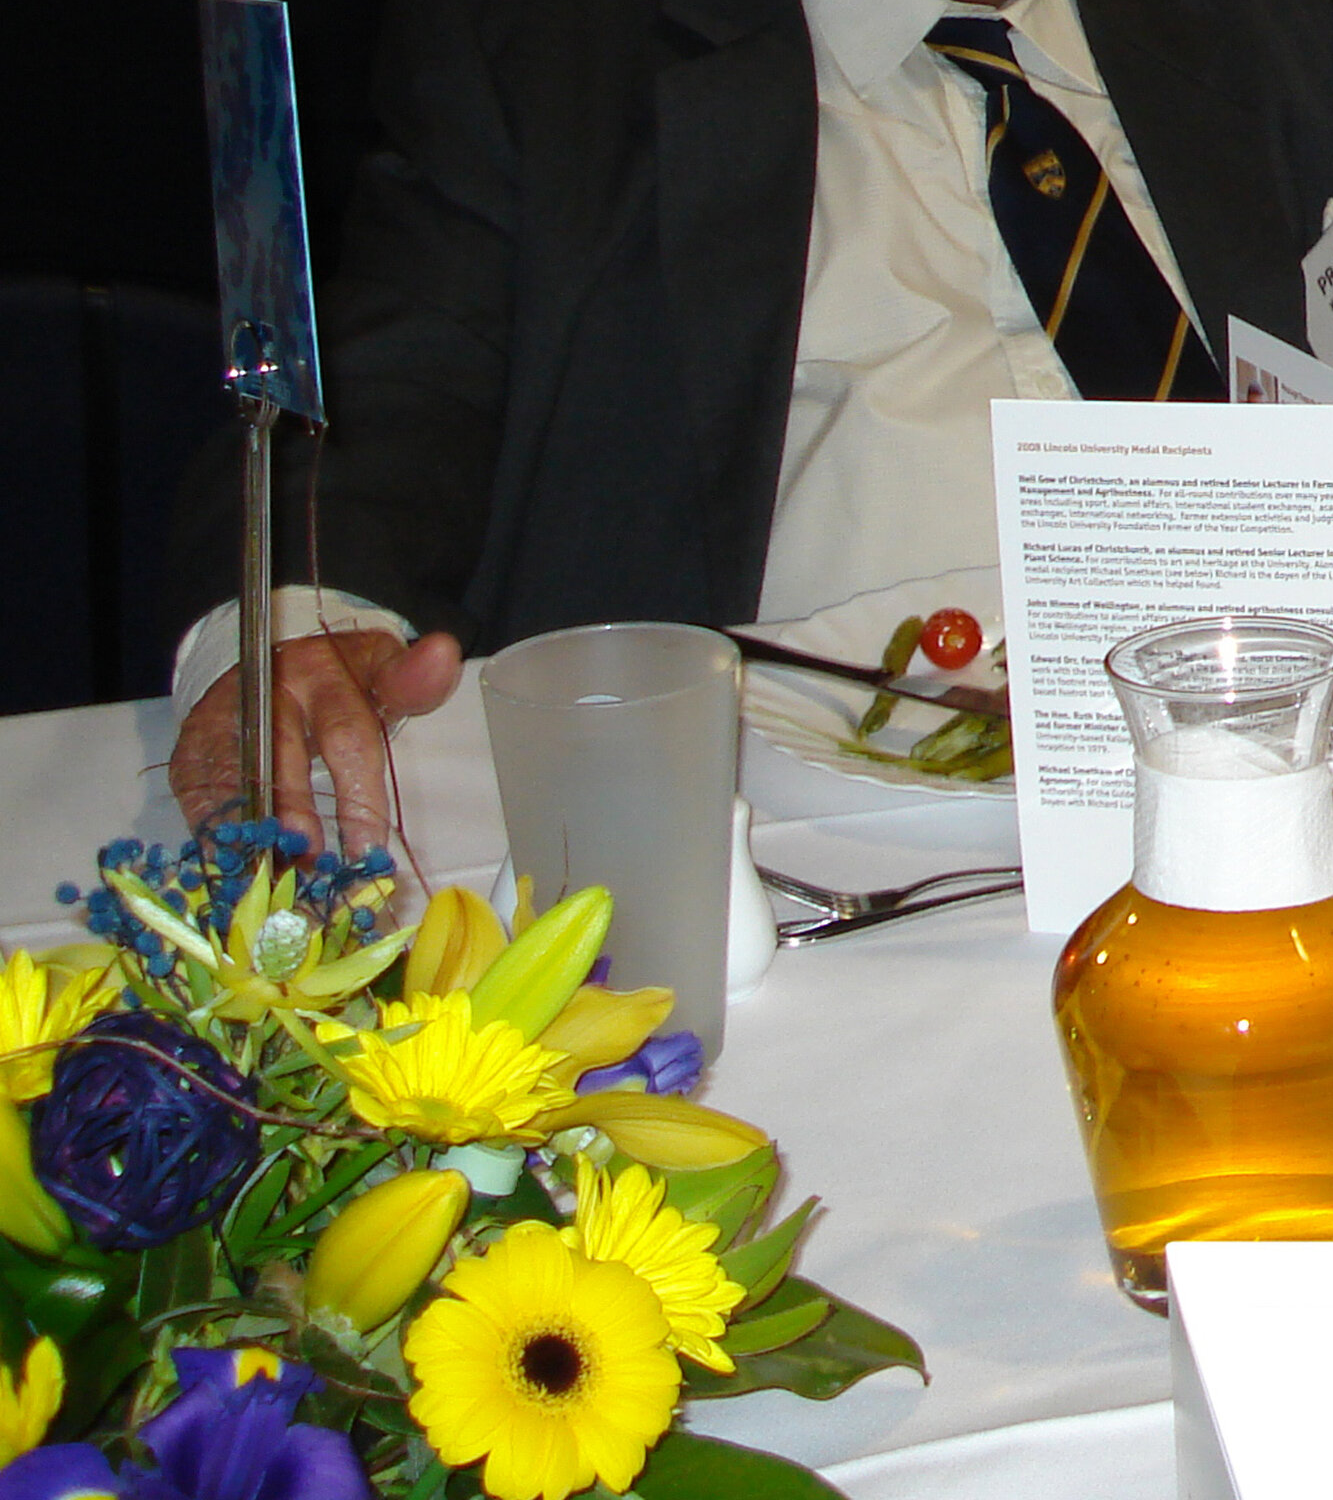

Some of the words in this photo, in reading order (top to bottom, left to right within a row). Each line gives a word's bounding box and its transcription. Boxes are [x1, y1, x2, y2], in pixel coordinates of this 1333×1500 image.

[1016, 443, 1040, 452] 2008
[1043, 443, 1077, 453] Lincoln
[1080, 444, 1128, 455] University
[1131, 445, 1159, 454] Medal
[1162, 445, 1213, 456] Recipients
